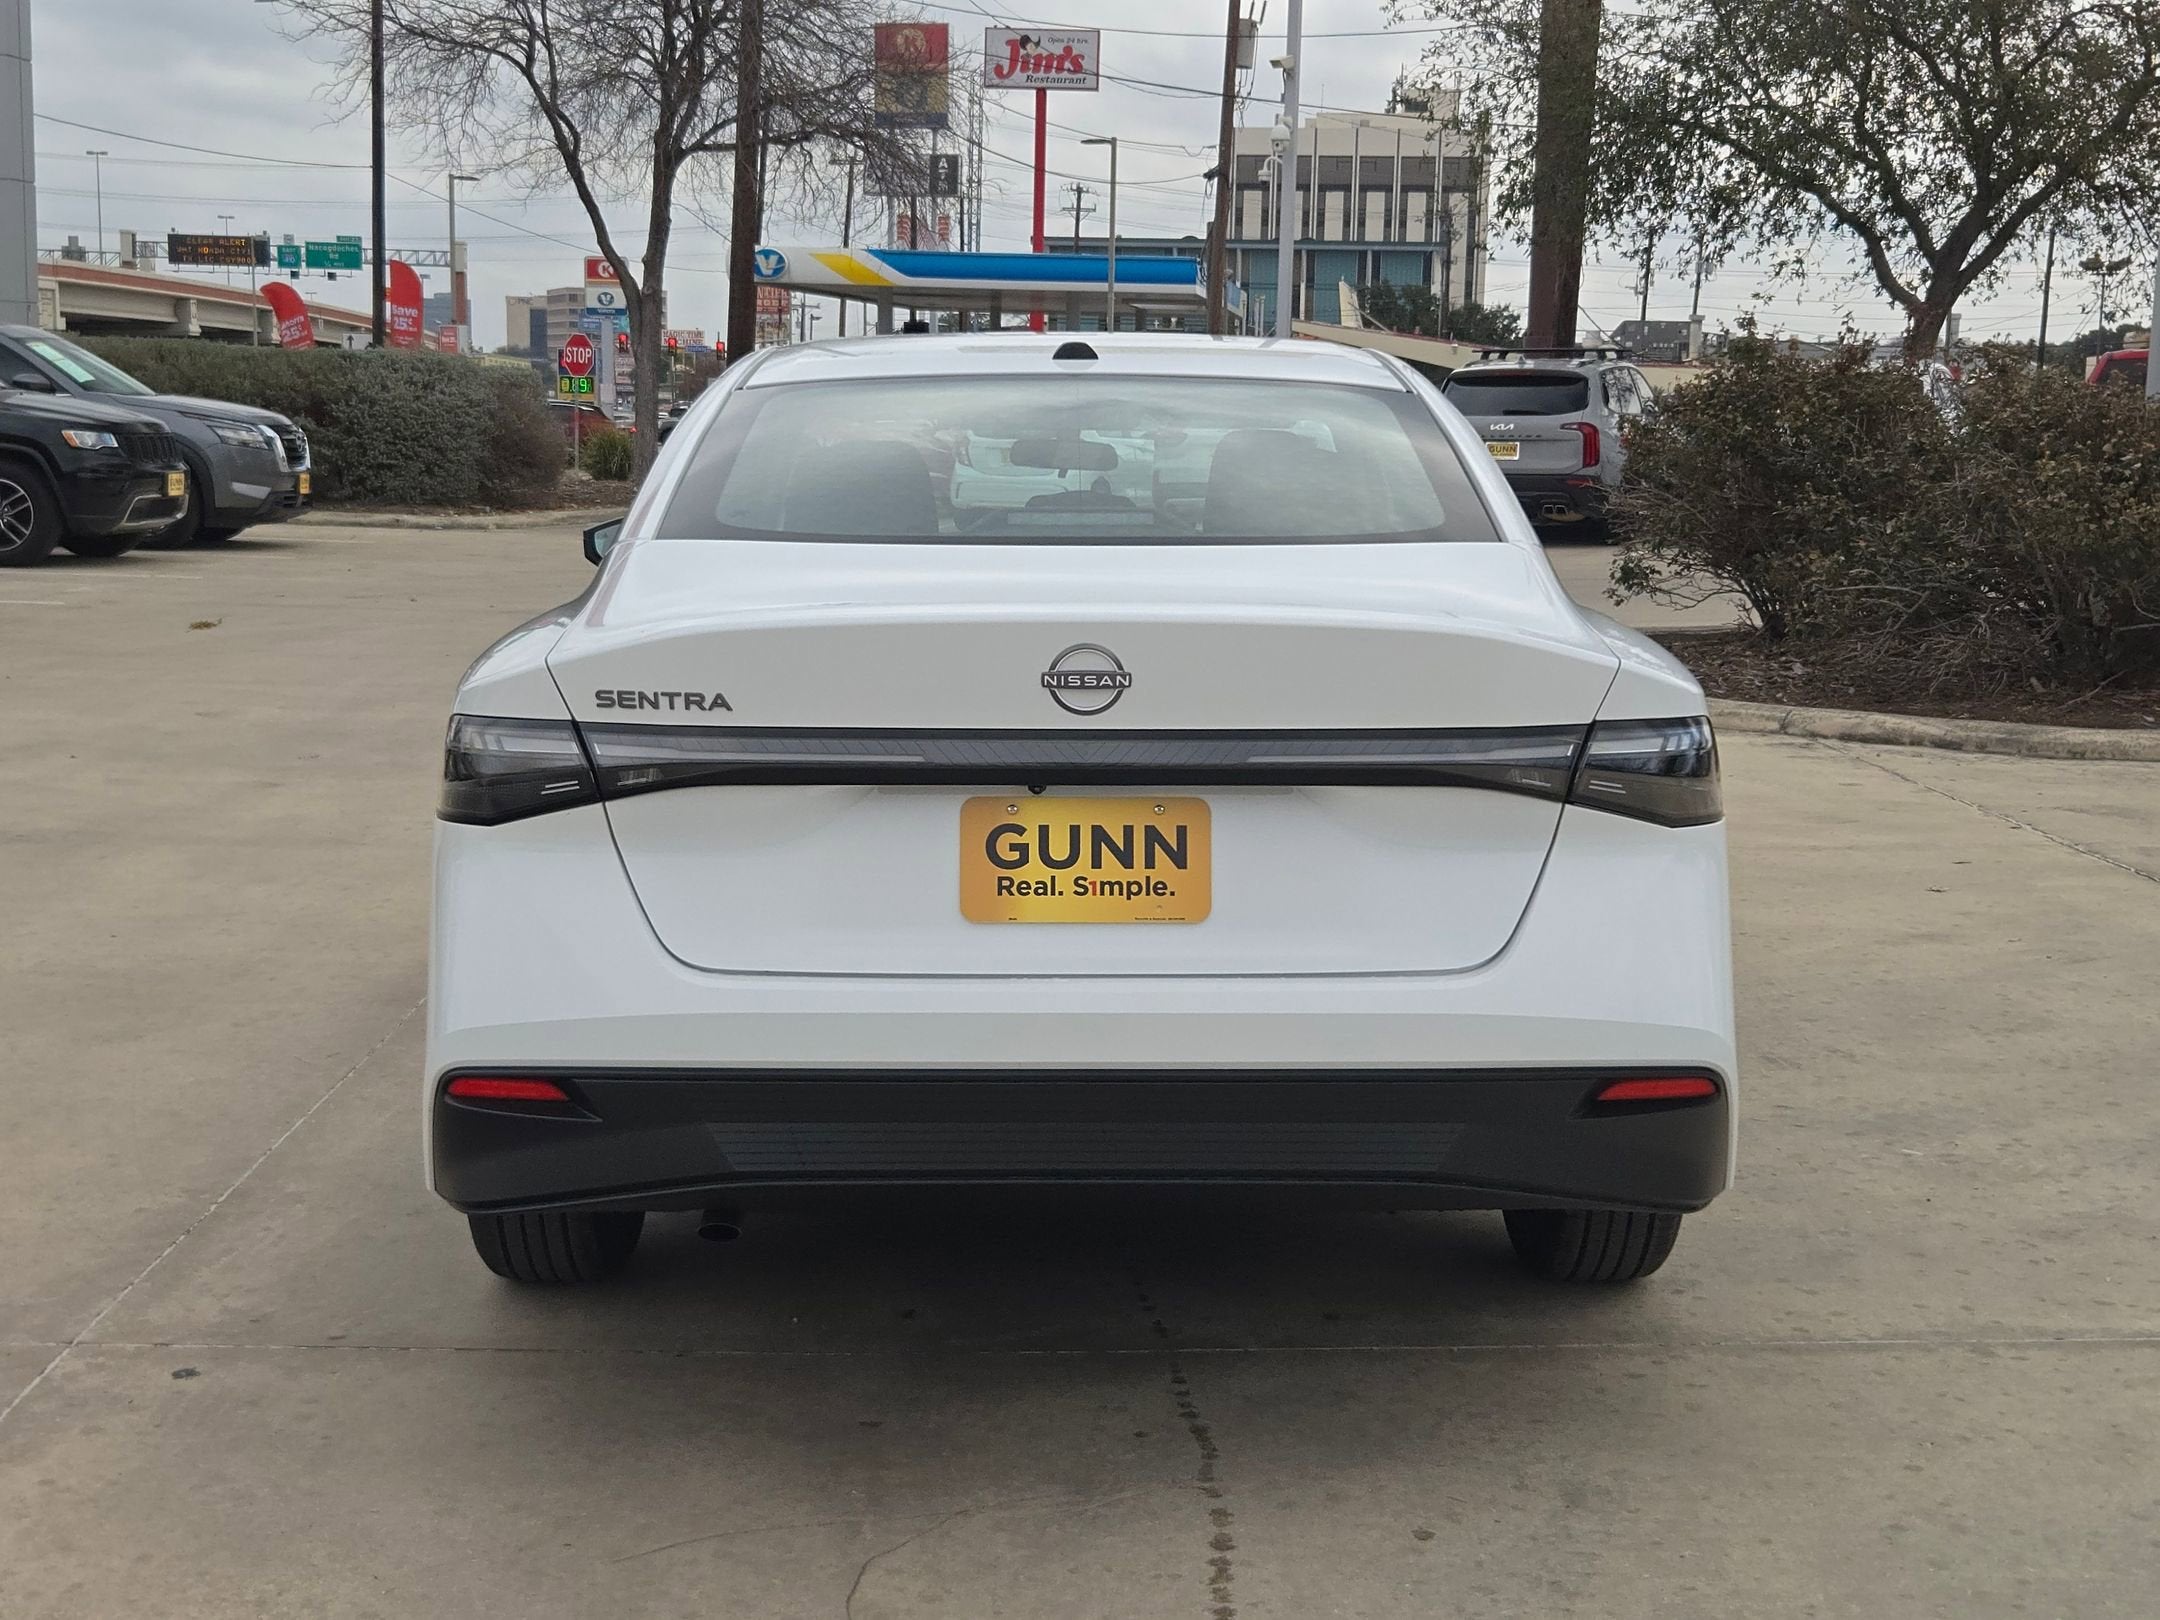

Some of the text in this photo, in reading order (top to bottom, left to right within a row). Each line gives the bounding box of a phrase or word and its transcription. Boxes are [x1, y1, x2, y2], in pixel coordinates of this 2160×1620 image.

[993, 38, 1085, 80] Jim's
[1025, 74, 1087, 85] Restaurant
[392, 304, 418, 318] Save
[663, 337, 704, 346] MCHINE
[566, 349, 592, 364] STOP
[1488, 445, 1516, 453] GUNN
[1043, 673, 1131, 687] NISSAN
[594, 689, 733, 712] SENTRA
[985, 822, 1188, 870] GUNN
[997, 875, 1064, 897] Real.
